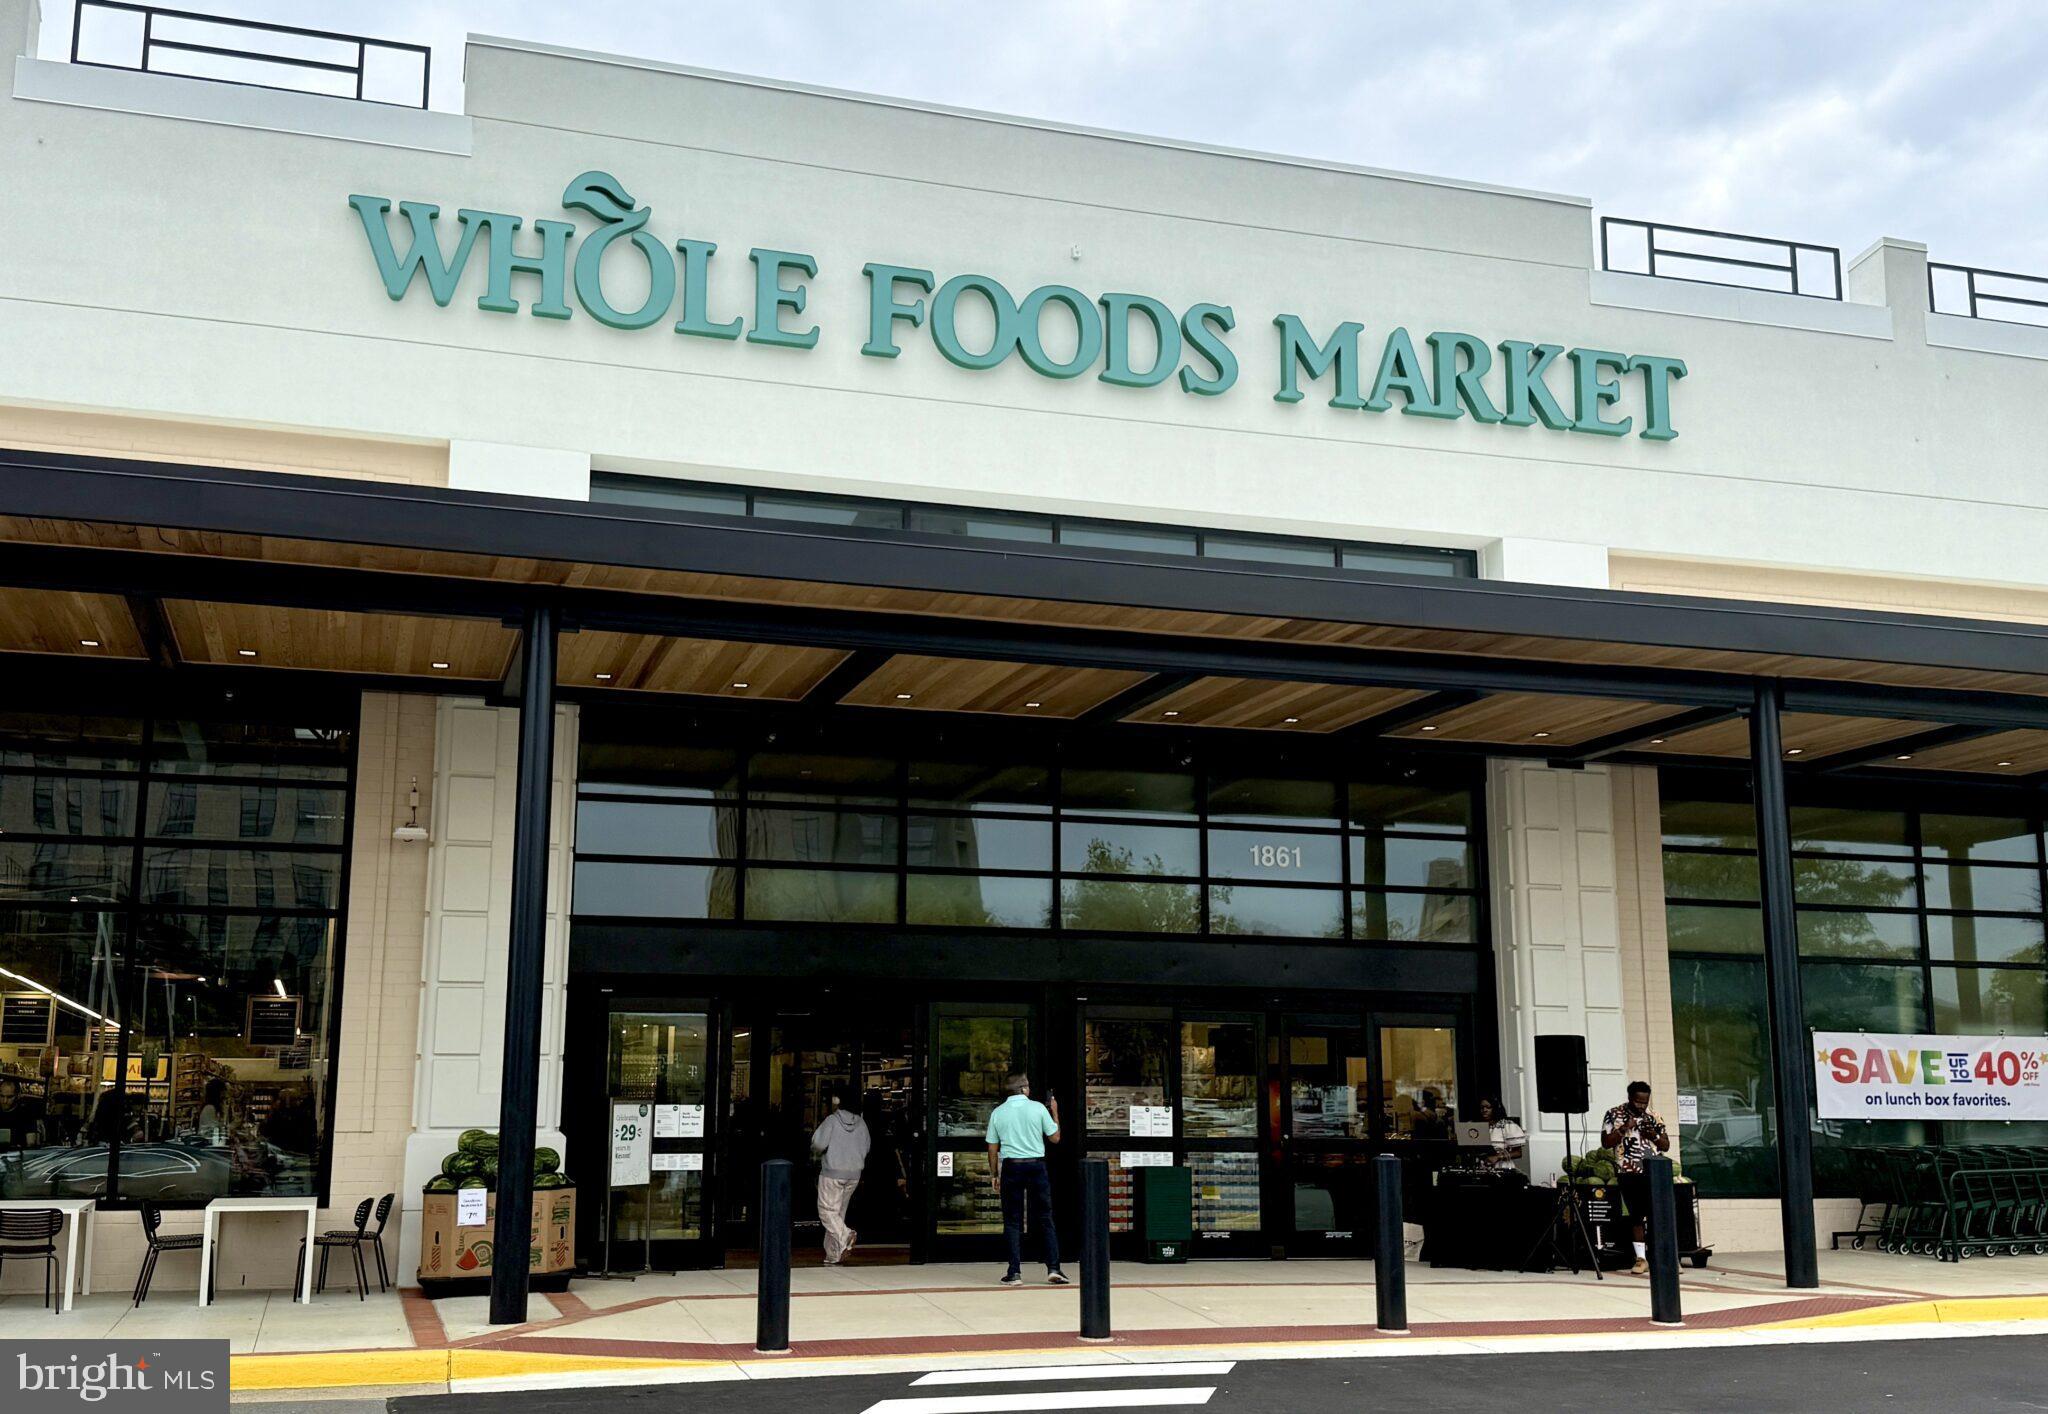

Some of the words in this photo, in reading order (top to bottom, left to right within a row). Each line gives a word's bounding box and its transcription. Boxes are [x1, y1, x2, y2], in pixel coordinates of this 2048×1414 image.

[348, 170, 821, 350] WHOLE
[861, 262, 1239, 396] FOODS
[1273, 313, 1688, 441] MARKET
[1249, 844, 1301, 868] 1861
[1830, 1047, 1946, 1085] SAVE
[1949, 1058, 1968, 1068] UP
[1950, 1069, 1970, 1079] TO
[2022, 1071, 2039, 1081] OFF
[1865, 1094, 1882, 1106] on
[1885, 1092, 1921, 1106] lunch
[1925, 1093, 1950, 1106] box
[1953, 1093, 2011, 1107] favorites.
[620, 1124, 636, 1141] 29
